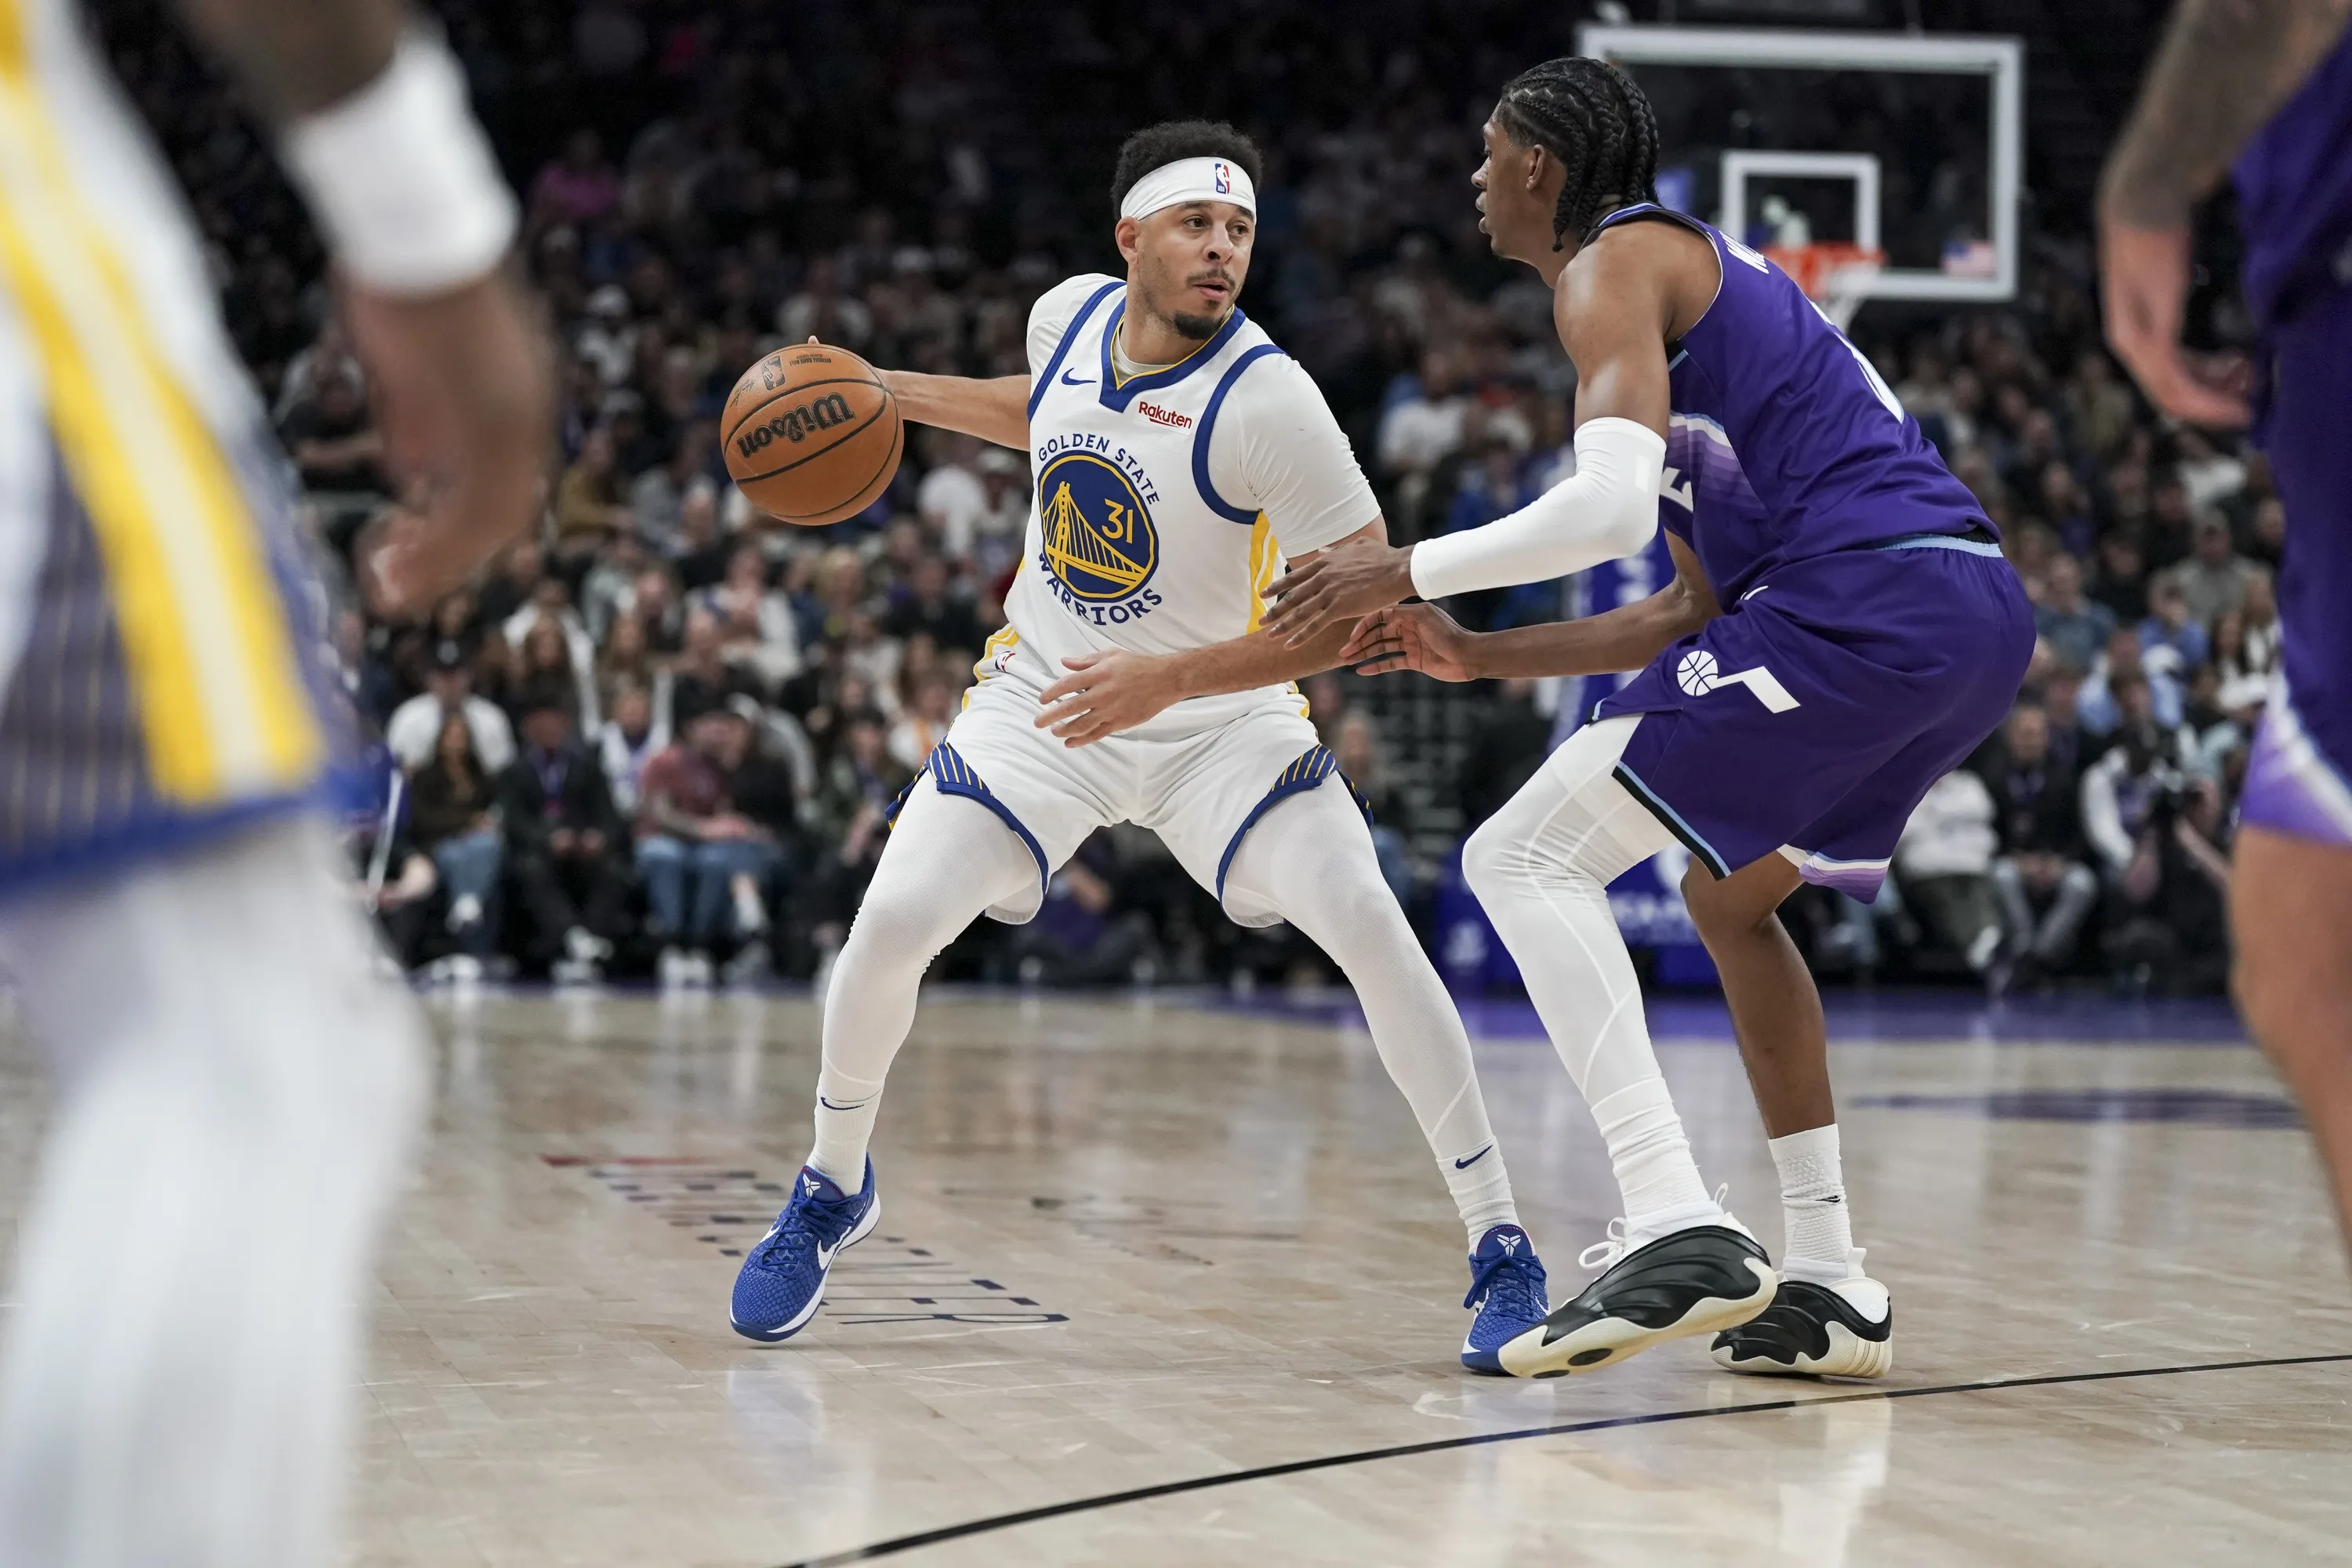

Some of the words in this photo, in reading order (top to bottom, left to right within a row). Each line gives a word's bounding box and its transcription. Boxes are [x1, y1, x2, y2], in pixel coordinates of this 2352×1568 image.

[736, 392, 856, 458] Wilson
[1138, 401, 1192, 429] Rakuten
[1038, 434, 1110, 462] GOLDEN
[1115, 448, 1160, 505] STATE
[1102, 499, 1134, 544] 31
[1039, 552, 1163, 626] WARRIORS
